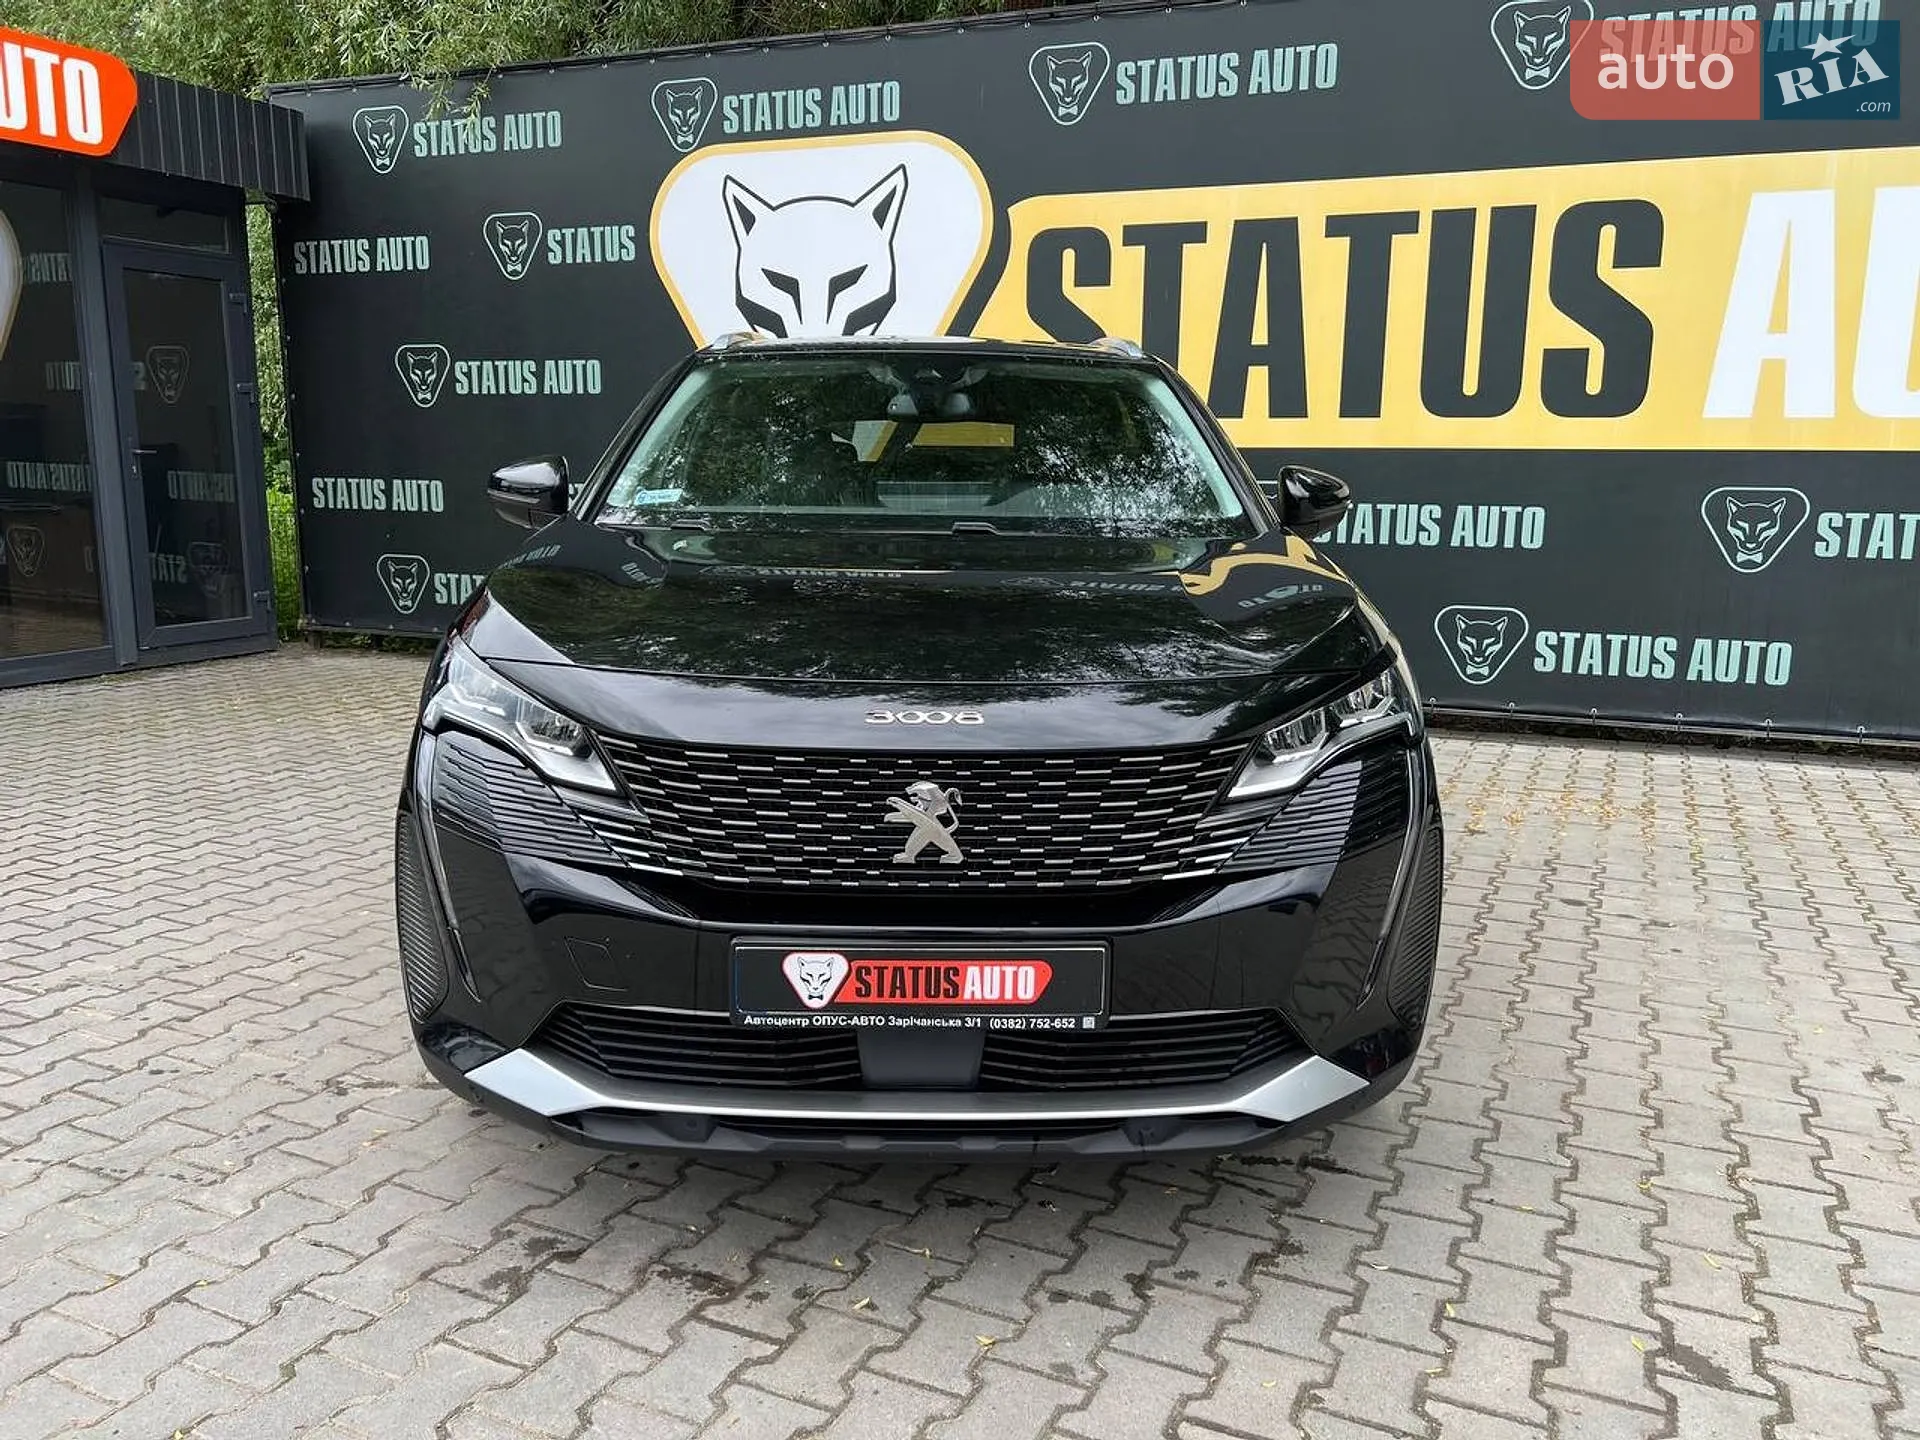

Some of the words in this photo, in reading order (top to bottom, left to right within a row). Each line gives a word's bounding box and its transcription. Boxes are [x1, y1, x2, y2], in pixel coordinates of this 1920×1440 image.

[1115, 52, 1240, 105] STATUS
[1248, 43, 1339, 95] AUTO
[722, 87, 822, 134] STATUS
[830, 80, 901, 127] AUTO
[413, 116, 497, 157] STATUS
[504, 111, 562, 150] AUTO
[294, 238, 371, 275] STATUS
[376, 235, 431, 272] AUTO
[547, 225, 636, 265] STATUS
[1026, 198, 1665, 418] STATUS
[455, 360, 537, 395] STATUS
[543, 359, 602, 395] AUTO
[312, 477, 387, 511] STATUS
[391, 479, 445, 513] AUTO
[1312, 503, 1441, 547] ATUS
[1450, 505, 1546, 549] AUTO
[1533, 630, 1679, 680] STATUS
[1686, 638, 1794, 686] AUTO
[864, 709, 985, 724] 3008
[855, 966, 960, 999] STATUS
[963, 966, 1036, 1000] AUTO
[744, 1015, 809, 1027] Автоцентр
[812, 1015, 885, 1026] ОПУС-АВТО
[989, 1016, 1026, 1029] (0382)
[1030, 1018, 1076, 1029] 752-652
